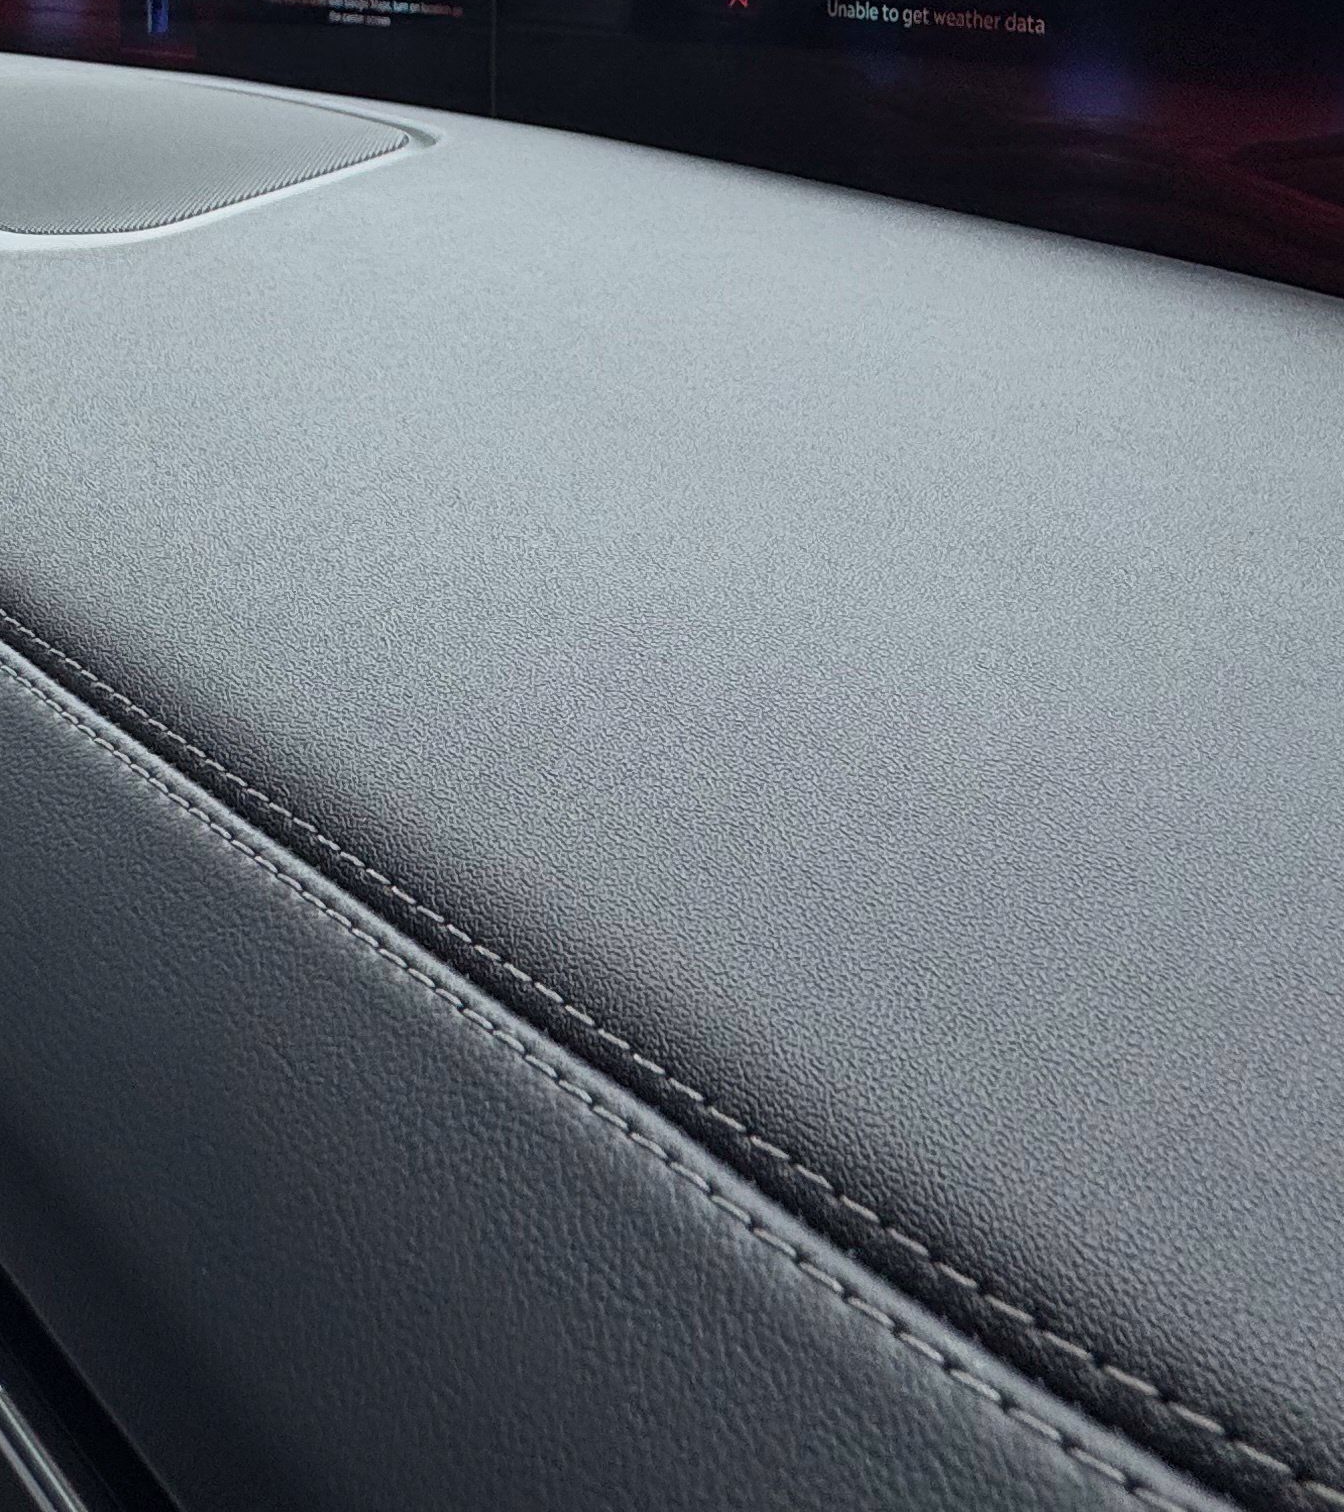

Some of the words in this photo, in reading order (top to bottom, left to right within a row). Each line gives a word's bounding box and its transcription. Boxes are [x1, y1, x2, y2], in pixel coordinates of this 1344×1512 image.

[882, 3, 899, 22] to
[902, 7, 930, 28] get
[933, 7, 1002, 30] weather
[1005, 11, 1046, 35] data
